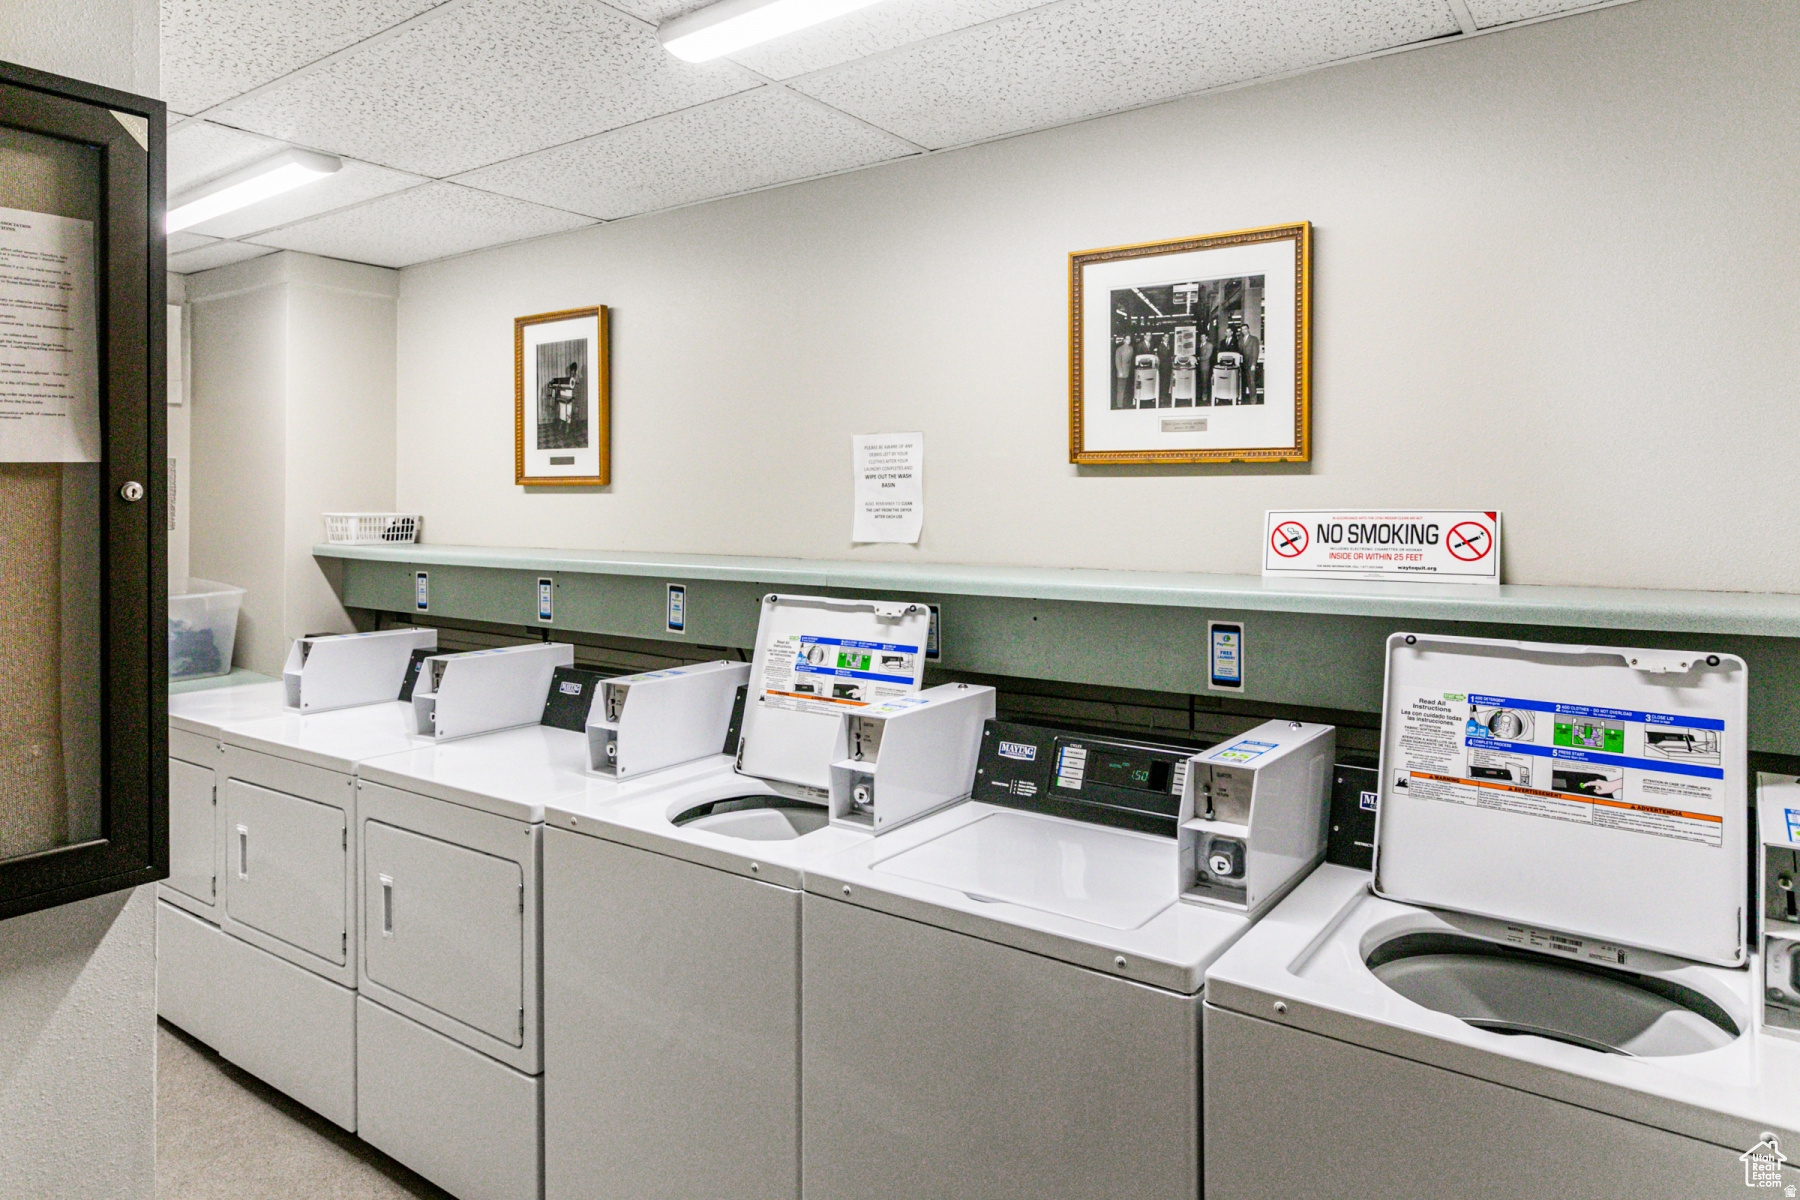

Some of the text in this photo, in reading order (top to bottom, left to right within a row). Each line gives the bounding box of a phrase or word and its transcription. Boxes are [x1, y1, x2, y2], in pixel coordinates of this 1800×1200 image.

[1317, 524, 1439, 545] NO SMOKING
[1413, 704, 1451, 712] Instructions
[1002, 744, 1034, 755] MAYTAG
[1434, 775, 1460, 783] WARNING
[1515, 787, 1562, 799] AVERTISSEMENT
[1637, 805, 1683, 816] ADVERTENCIA
